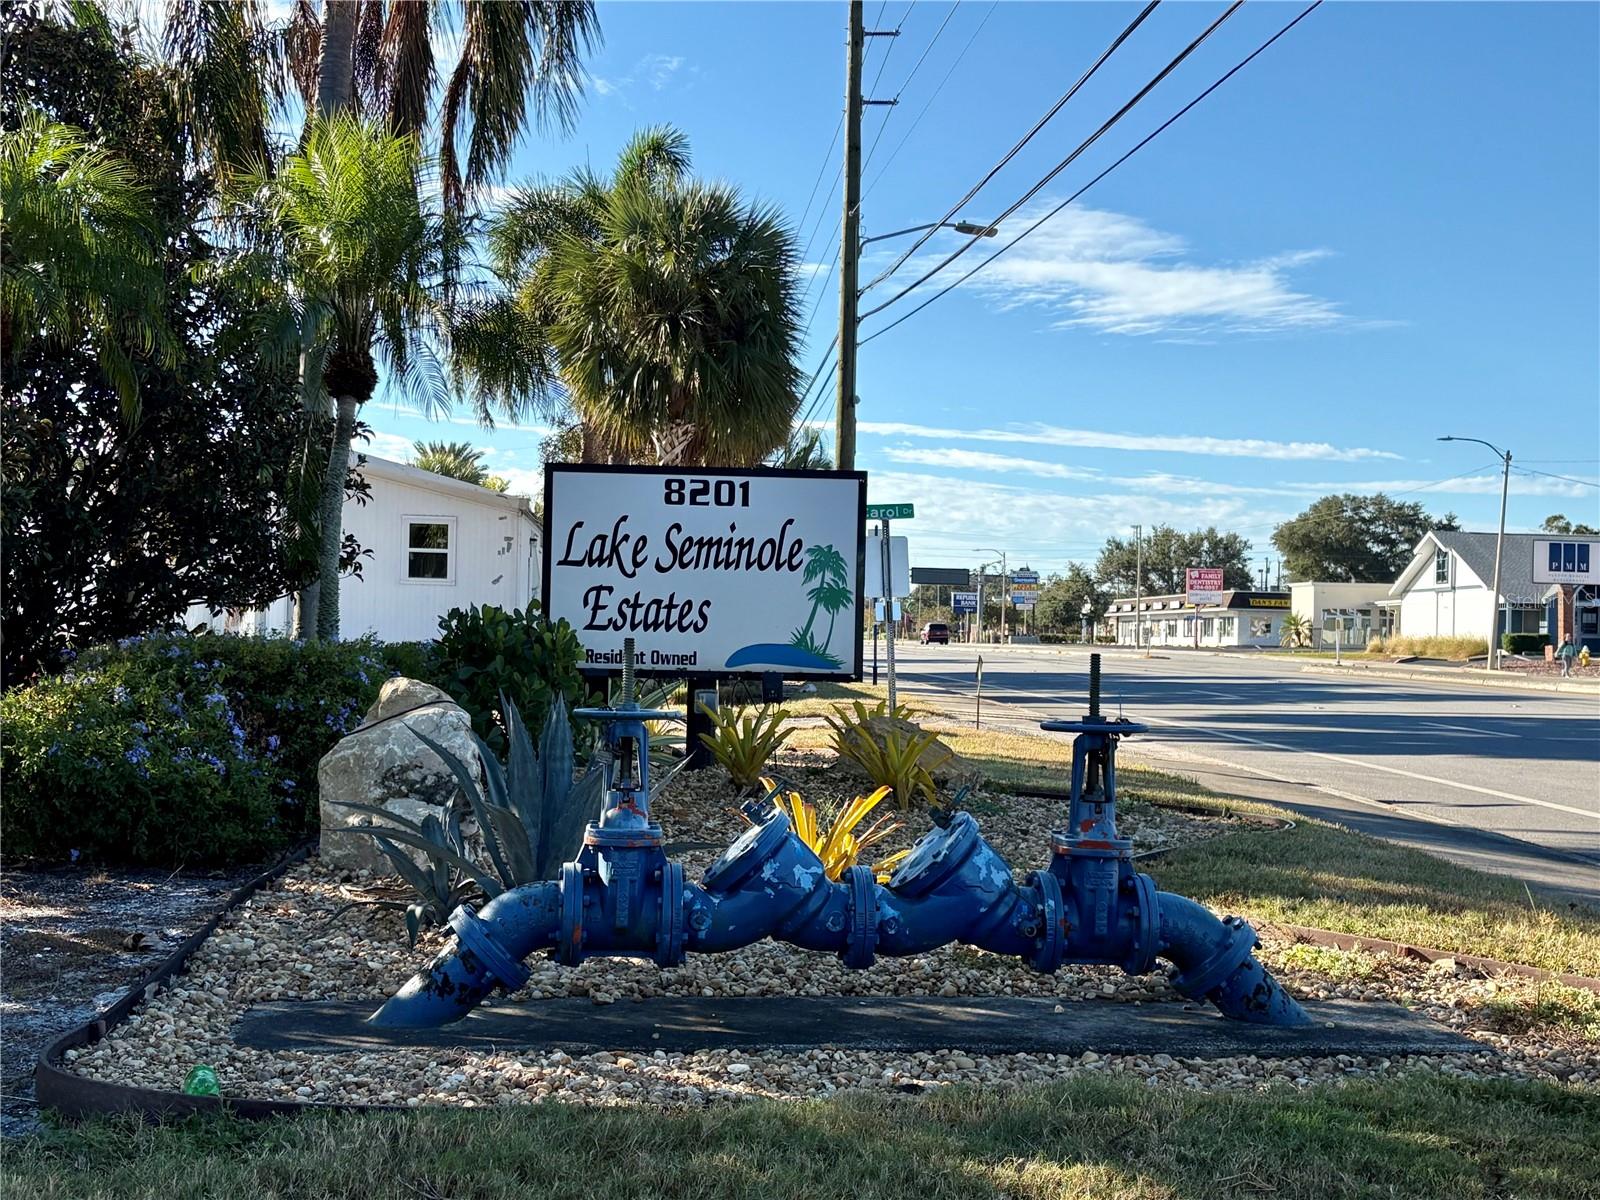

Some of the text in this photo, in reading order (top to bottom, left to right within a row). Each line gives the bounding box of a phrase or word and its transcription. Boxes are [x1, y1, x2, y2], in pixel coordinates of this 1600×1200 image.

[664, 478, 750, 507] 8201
[557, 515, 804, 579] Lake Seminole
[582, 584, 711, 633] Estates
[585, 648, 697, 666] Residnt Owned
